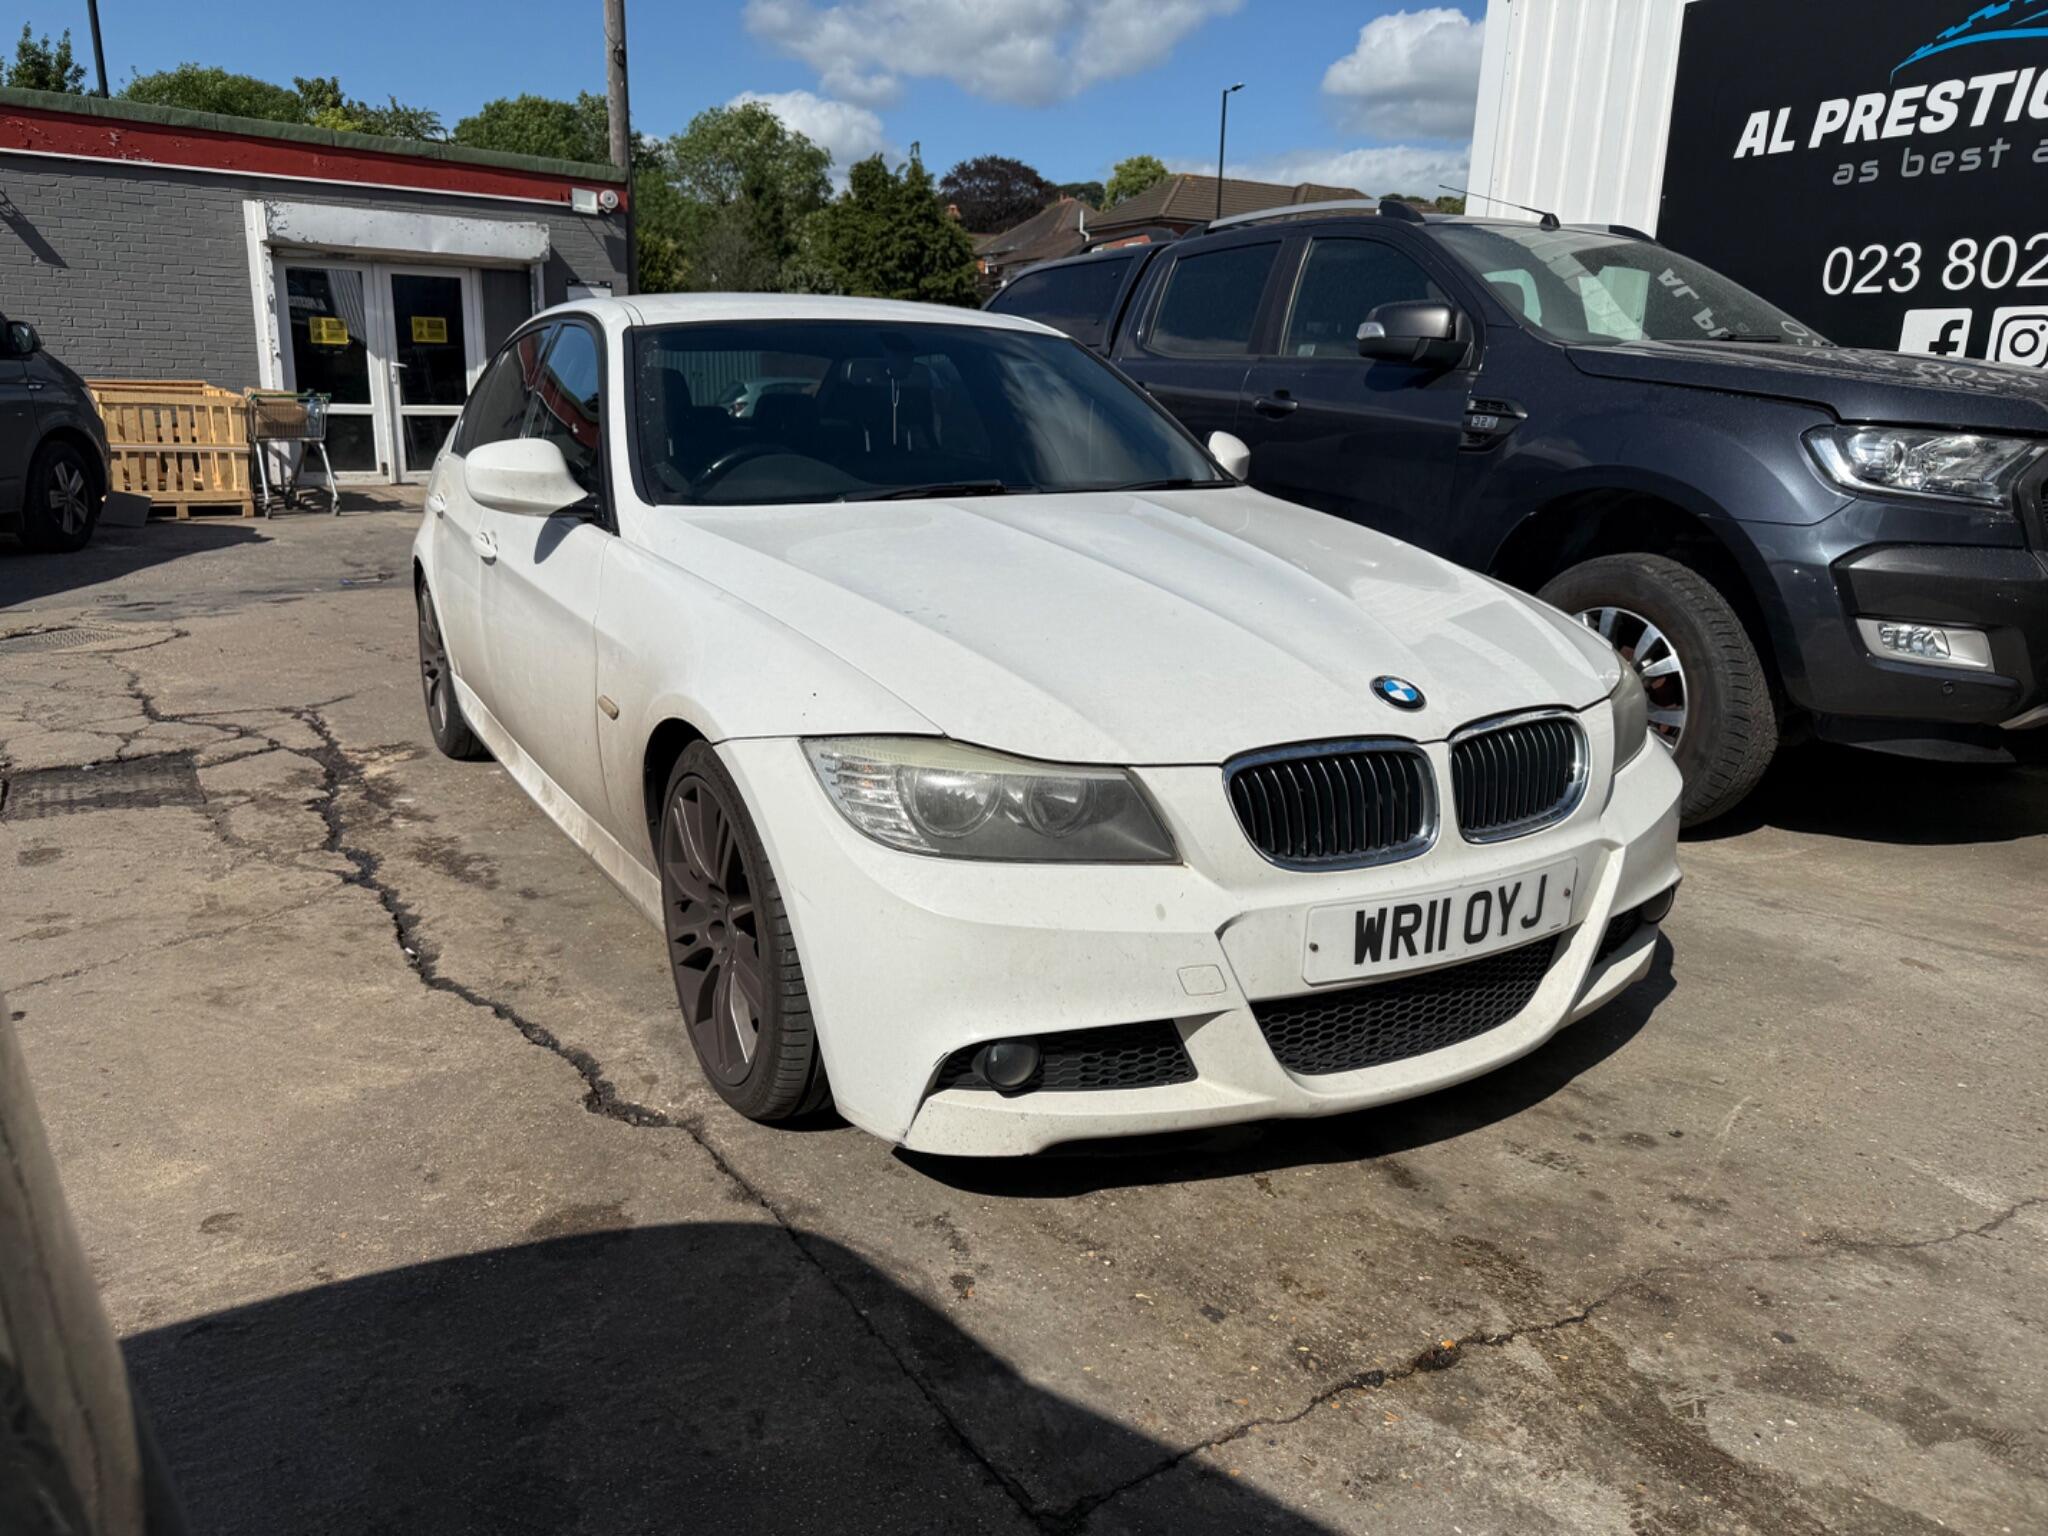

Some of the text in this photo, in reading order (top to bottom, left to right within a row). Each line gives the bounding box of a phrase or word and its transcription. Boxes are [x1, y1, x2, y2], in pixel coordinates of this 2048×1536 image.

[1733, 106, 1796, 159] AL
[1832, 159, 1880, 185] as
[1901, 137, 2011, 177] best
[1822, 232, 2048, 295] 023 802
[1354, 874, 1548, 966] WR11 OYJ
